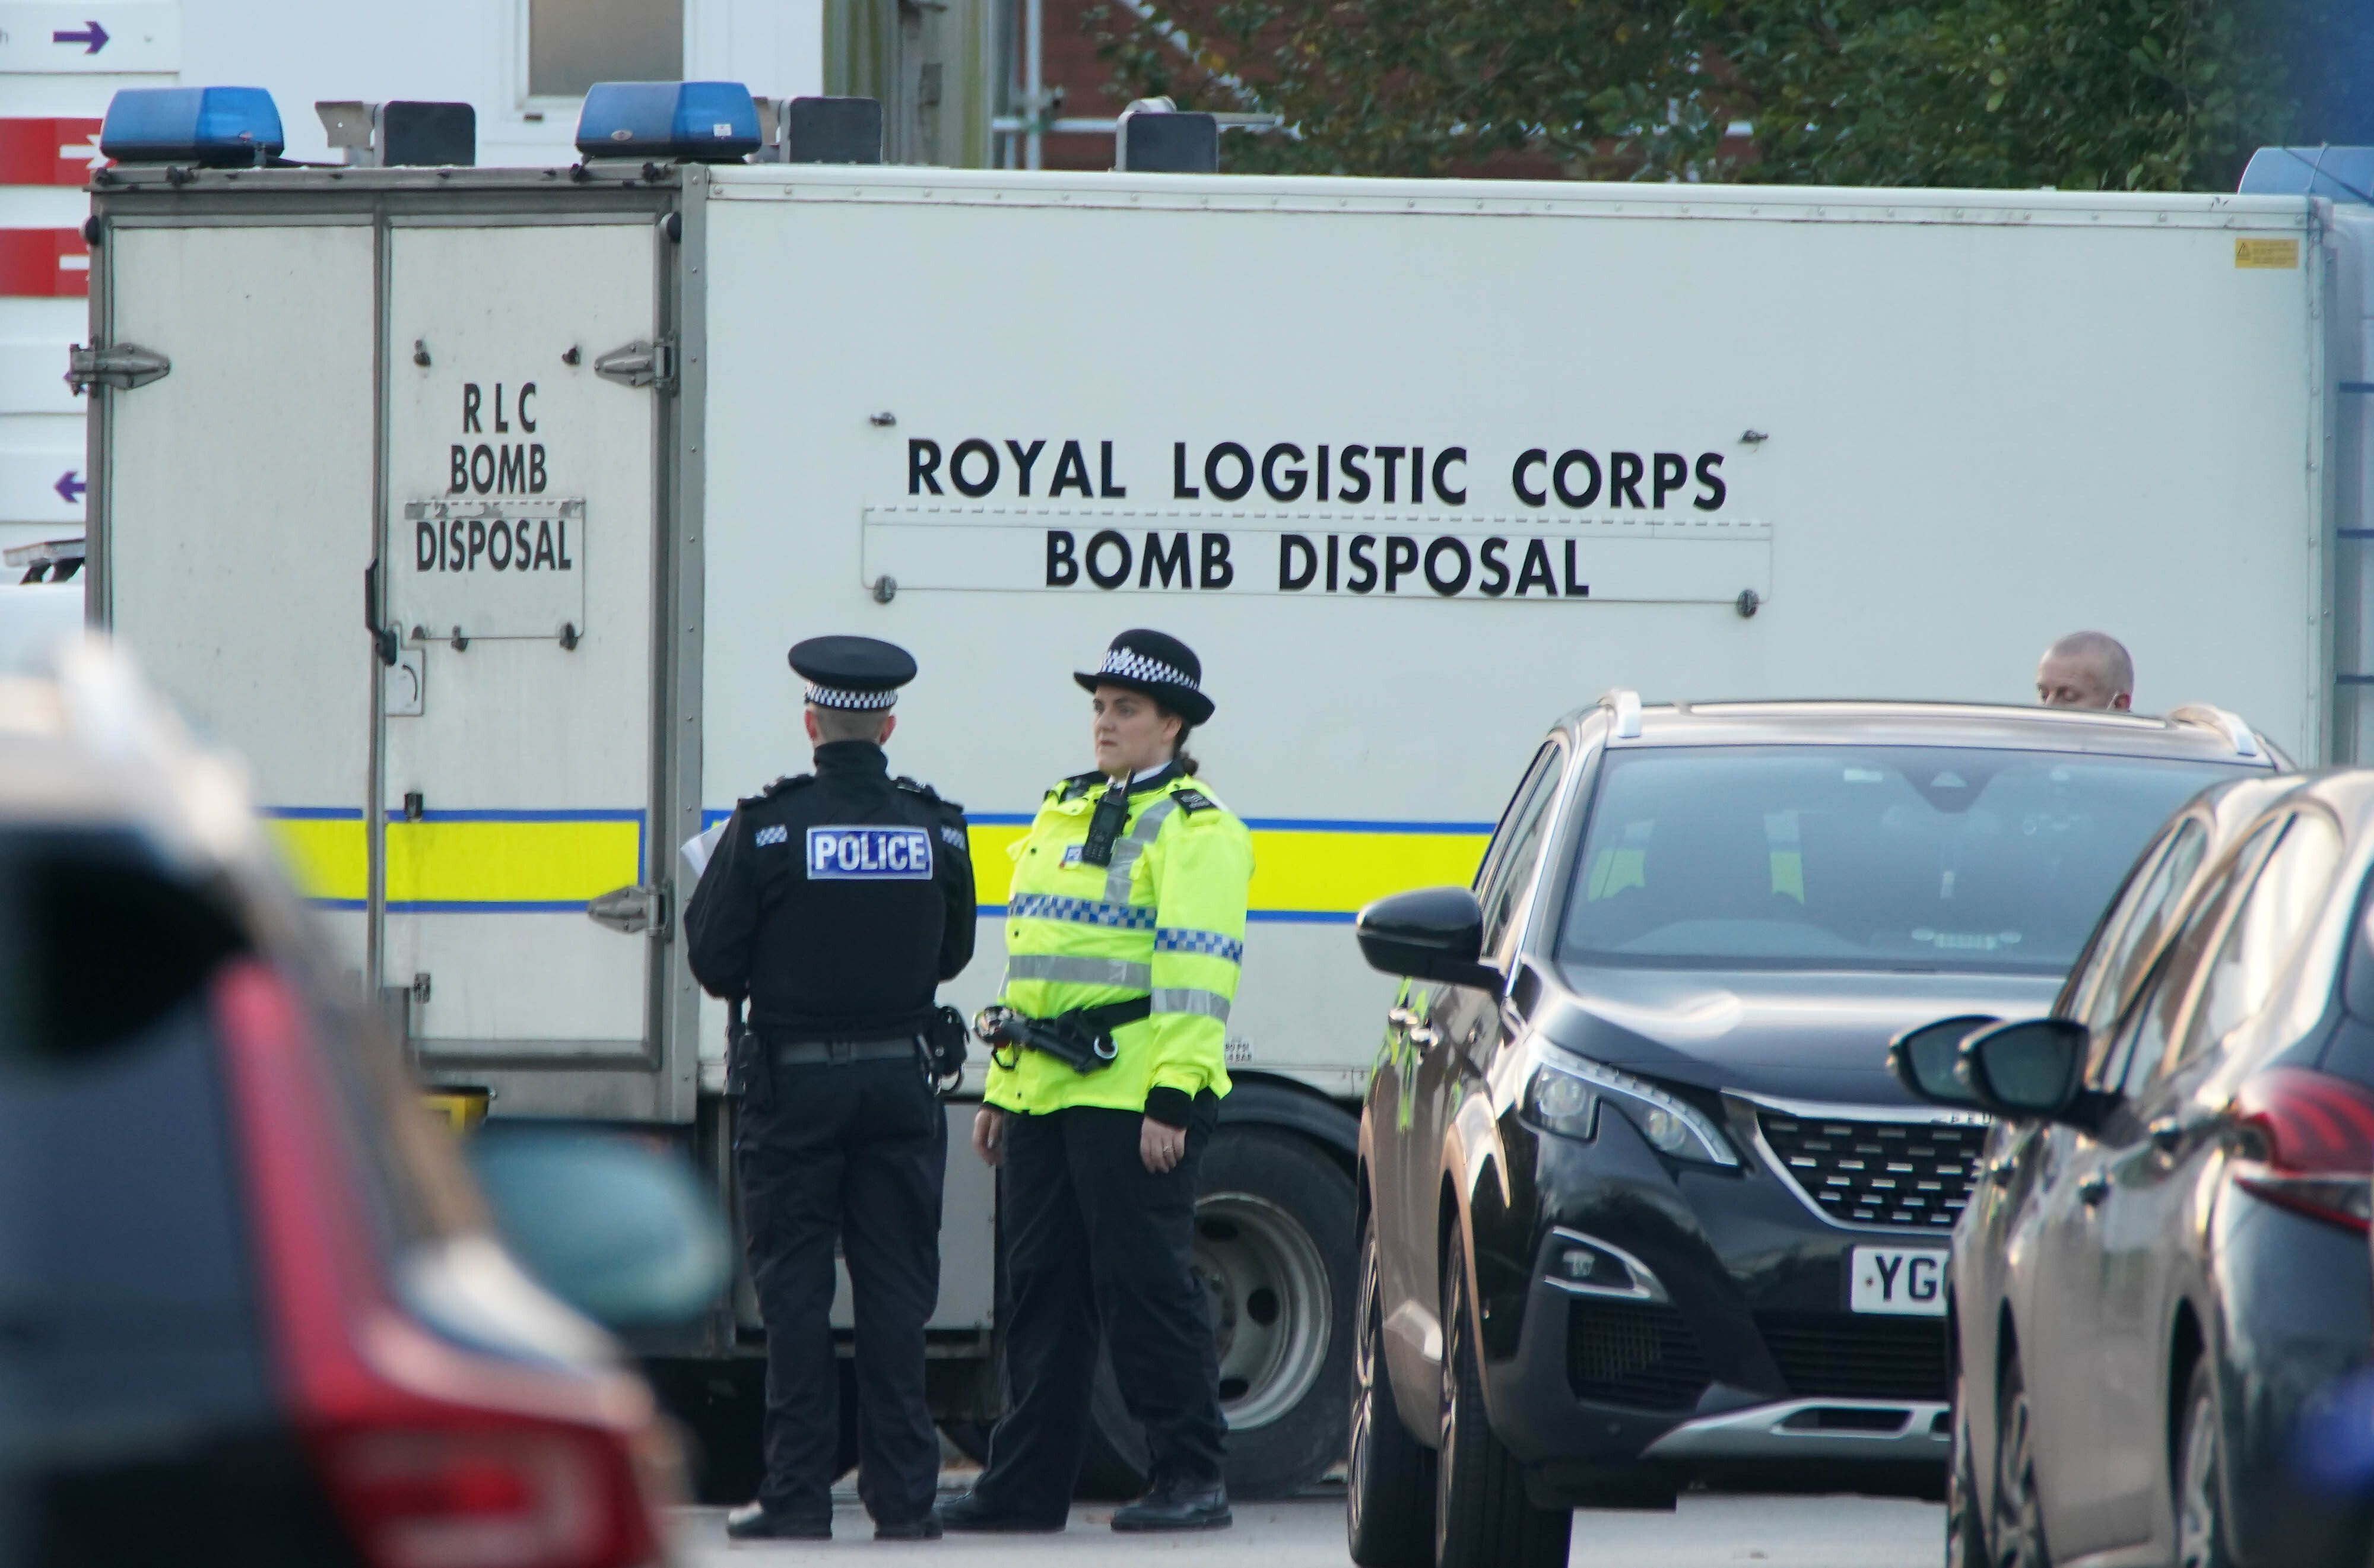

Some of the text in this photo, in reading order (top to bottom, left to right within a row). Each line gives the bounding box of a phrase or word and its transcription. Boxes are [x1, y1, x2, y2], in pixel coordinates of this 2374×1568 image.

[450, 443, 548, 496] BOMB
[908, 438, 1727, 512] ROYAL LOGISTIC CORPS
[415, 519, 572, 573] DISPOSAL
[1045, 529, 1590, 598] BOMB DISPOSAL
[814, 833, 927, 871] POLICE
